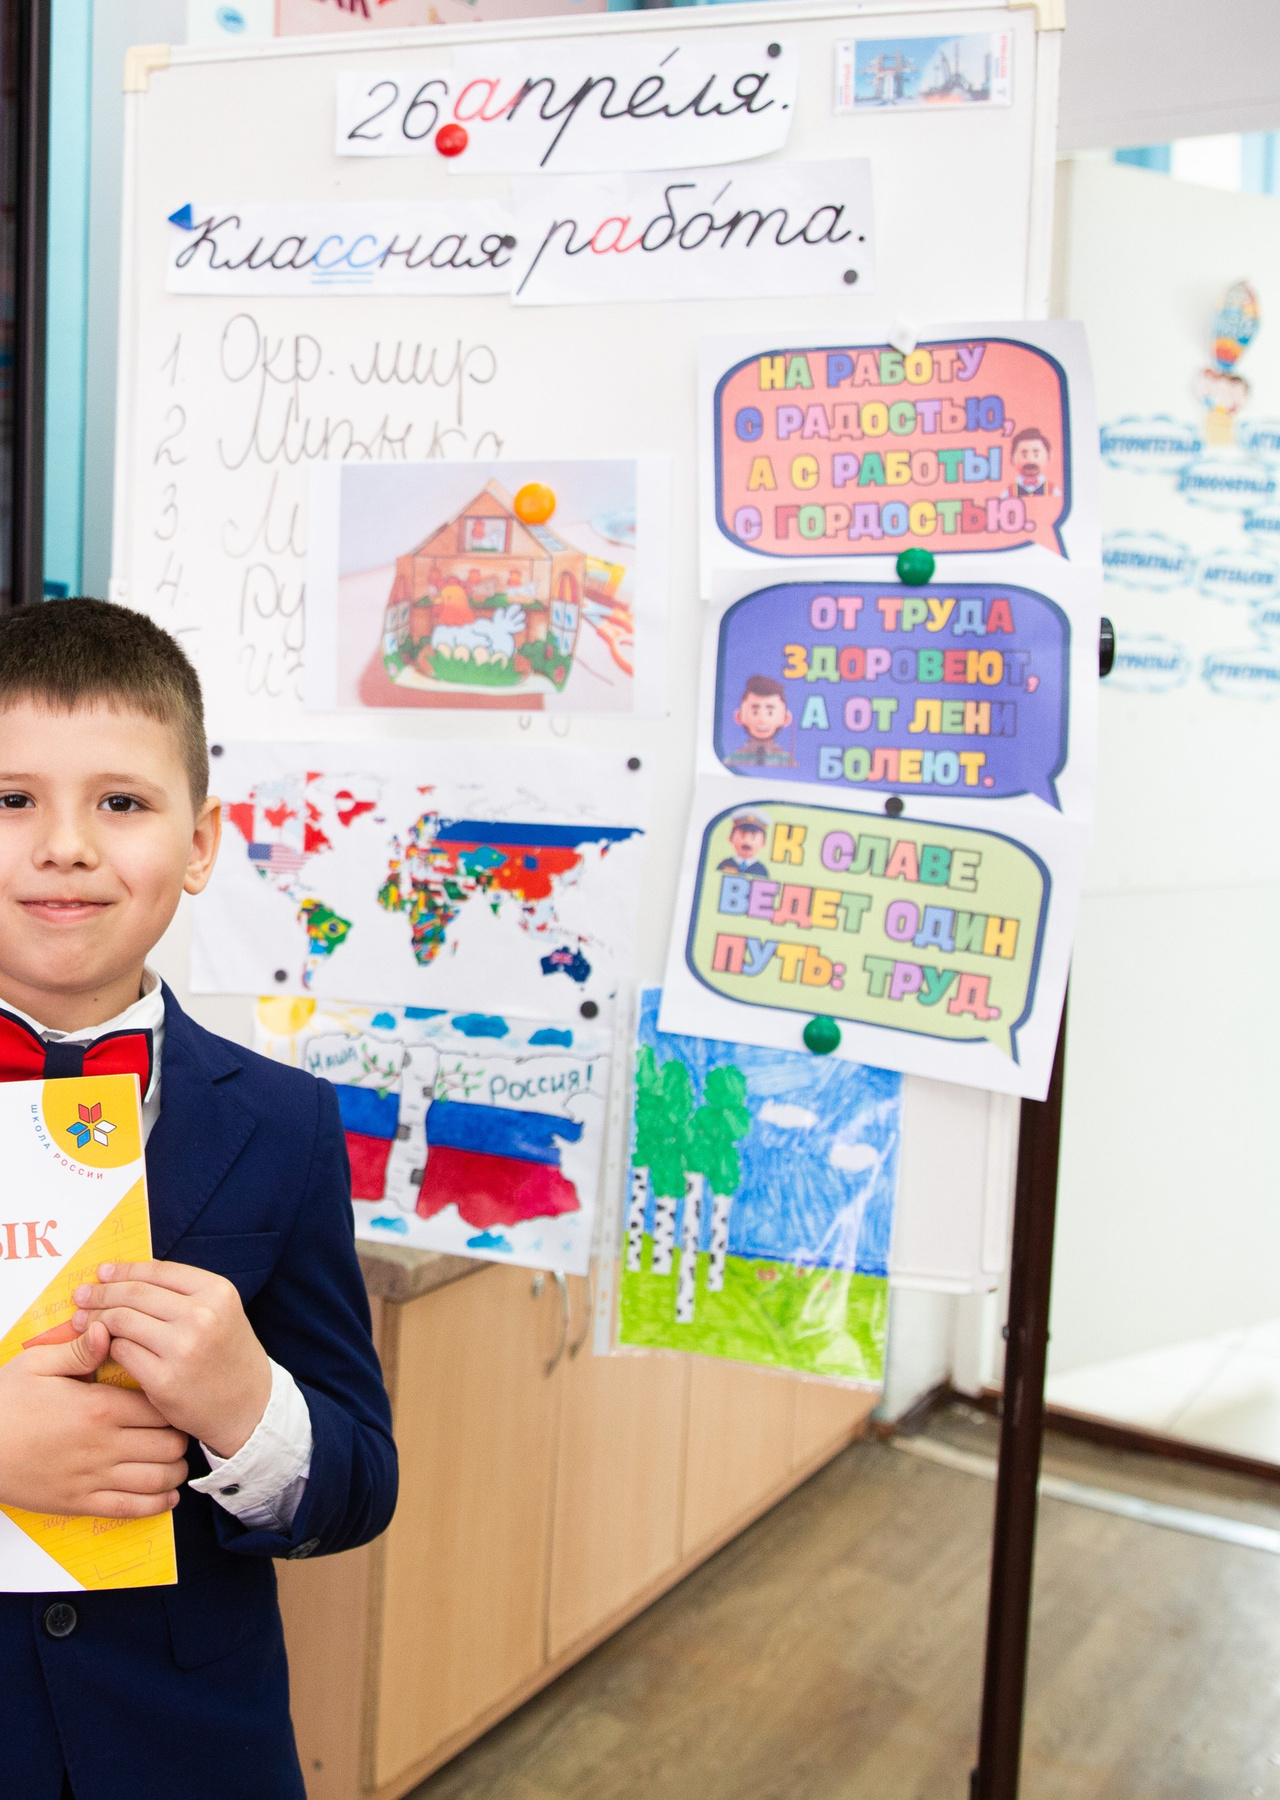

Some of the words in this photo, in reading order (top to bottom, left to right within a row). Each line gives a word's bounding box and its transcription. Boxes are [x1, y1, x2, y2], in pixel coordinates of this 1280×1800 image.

[347, 79, 449, 142] 26
[175, 215, 511, 271] Классная
[350, 338, 498, 426] мир
[759, 351, 813, 392] НА
[826, 344, 988, 389] РАБОТУ
[735, 405, 764, 443] С
[776, 395, 1016, 441] РАДОСТЬЮ,
[747, 455, 776, 491] А
[791, 453, 819, 490] С
[832, 446, 1004, 488] РАБОТЫ
[733, 505, 763, 542] С
[775, 498, 1037, 541] ГОРДОСТЬЮ.
[809, 596, 864, 632] ОТ
[877, 597, 1016, 637] ТРУДА
[782, 644, 1041, 694] ЗДОРОВЕЮТ,
[800, 696, 830, 731] А
[844, 695, 899, 733] ОТ
[909, 698, 1019, 739] ЛЕНИ
[817, 746, 995, 789] БОЛЕЮТ.
[770, 822, 808, 866] К
[821, 830, 983, 893] СЛАВЕ
[717, 874, 873, 934] ВЕДЕТ
[884, 900, 1021, 961] ОДИН
[710, 932, 847, 991] ПУТЬ:
[863, 954, 1002, 1022] ТРУД.
[30, 1104, 51, 1150] ШКОЛА
[53, 1152, 104, 1180] РОССИИ
